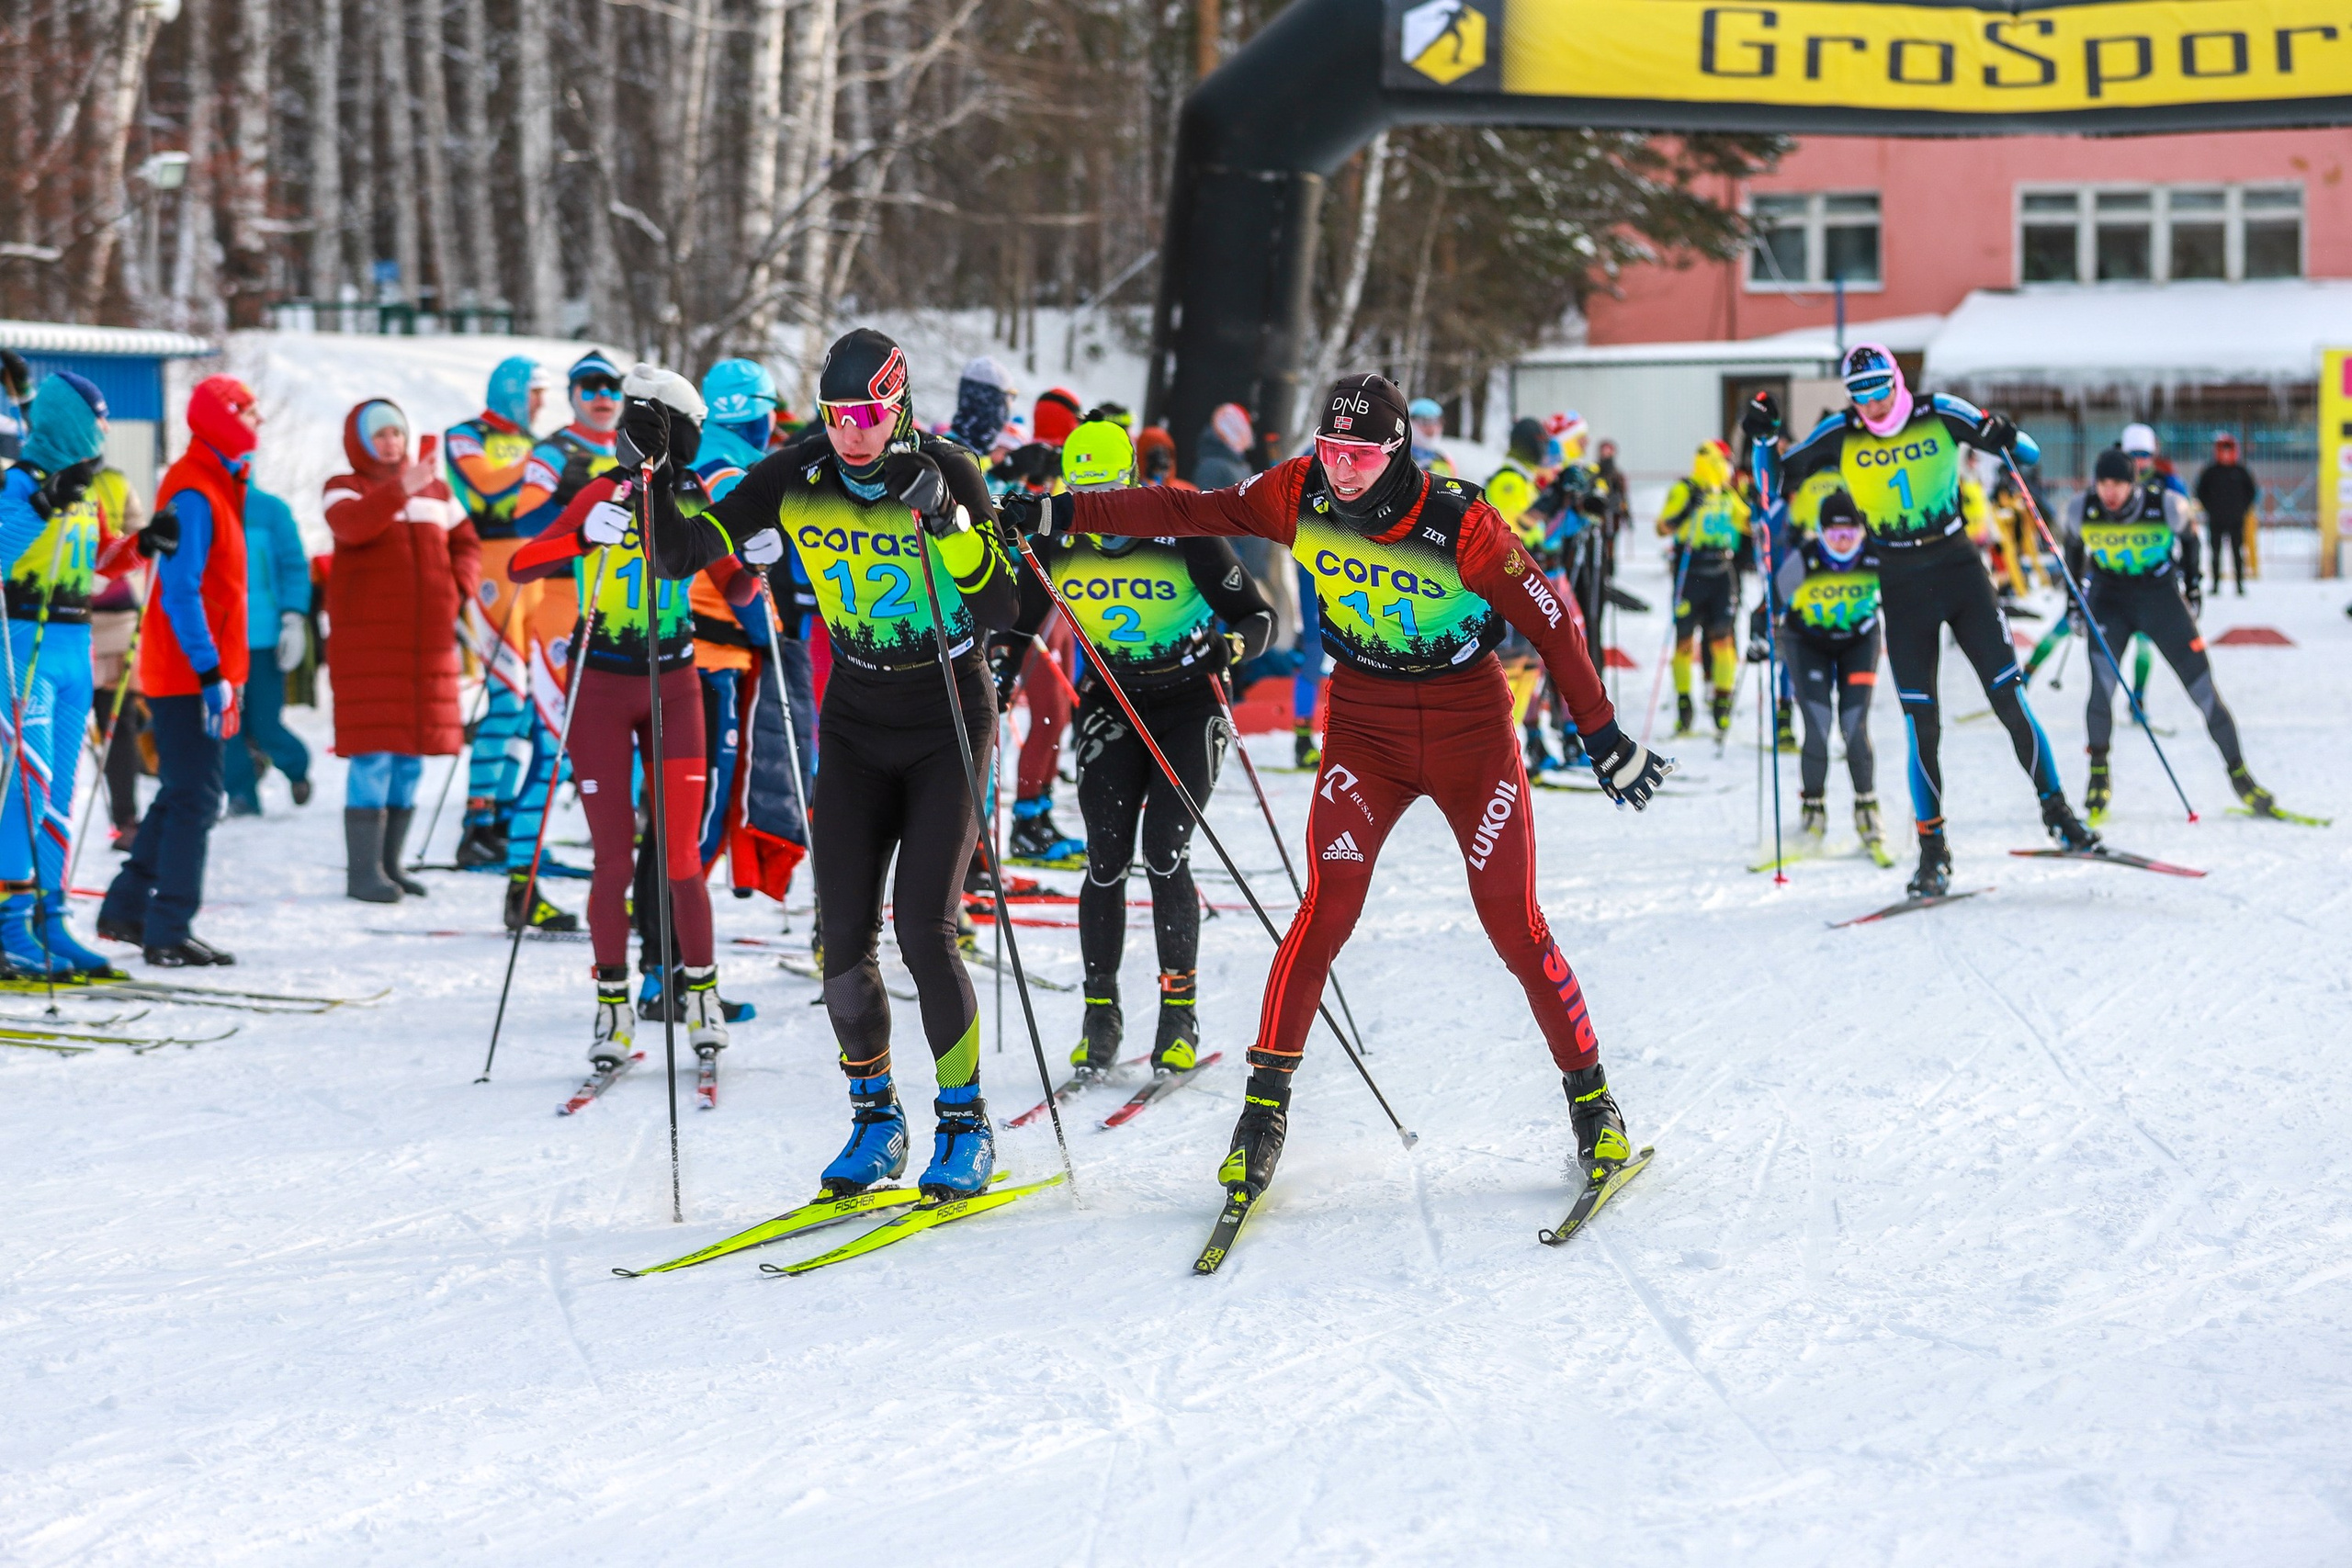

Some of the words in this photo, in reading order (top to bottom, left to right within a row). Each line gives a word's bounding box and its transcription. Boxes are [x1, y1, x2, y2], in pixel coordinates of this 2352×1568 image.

[1701, 7, 2352, 98] GroSpor
[1332, 390, 1371, 416] DNB
[1888, 468, 1914, 510] 1
[822, 558, 918, 619] 12
[1063, 579, 1178, 601] согаз
[1316, 549, 1447, 599] согаз
[1339, 590, 1419, 637] 11
[1522, 573, 1563, 630] LUKOIL
[1102, 605, 1147, 643] 2
[1349, 791, 1374, 827] RUSAL
[1469, 780, 1518, 872] LUKOIL
[1322, 849, 1365, 863] adidas
[943, 1110, 974, 1118] SPINE
[834, 1194, 876, 1213] FISCHER
[936, 1201, 968, 1221] FISCHER
